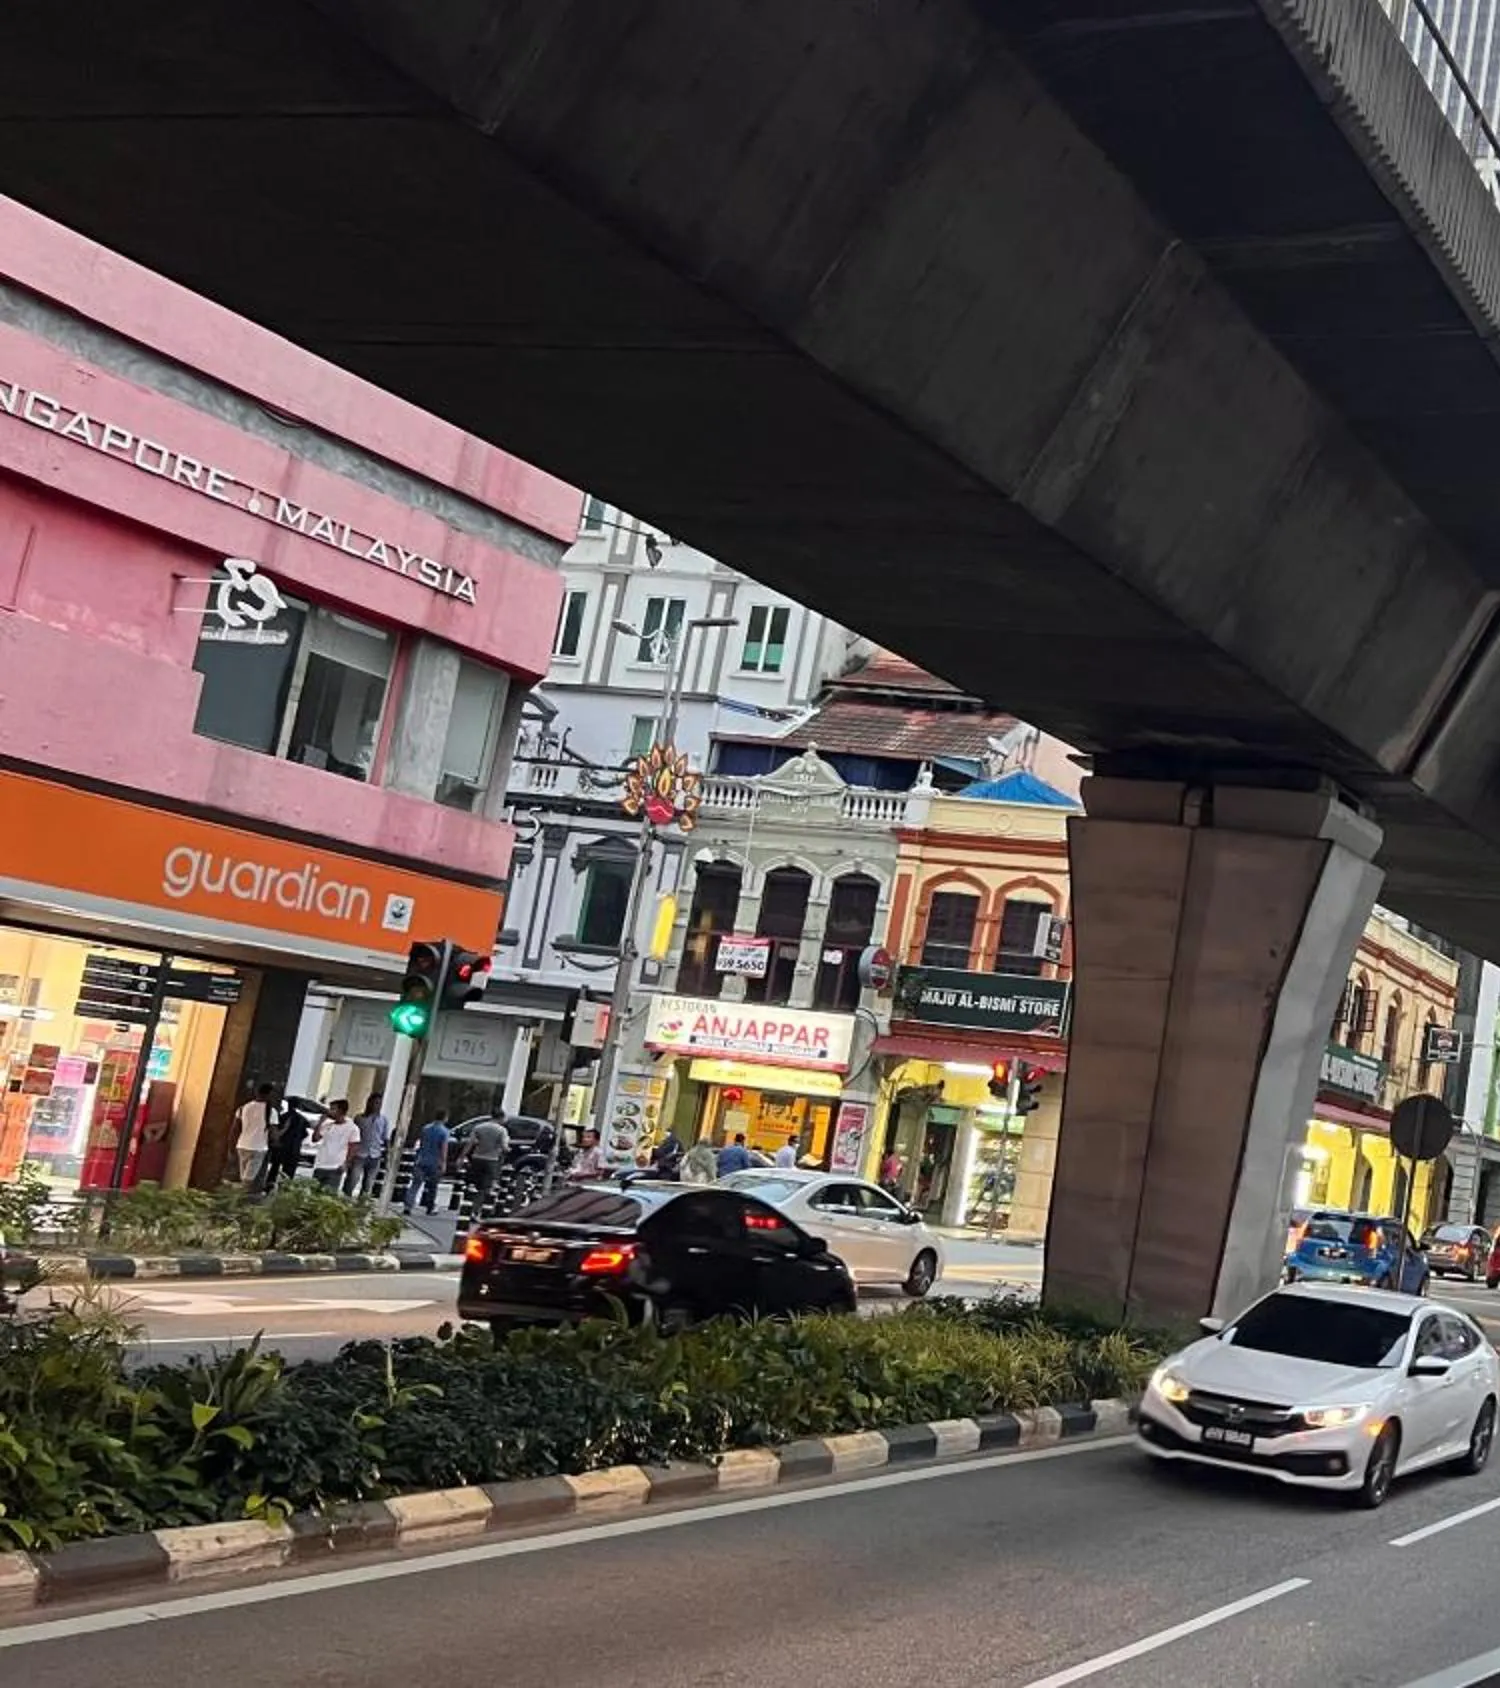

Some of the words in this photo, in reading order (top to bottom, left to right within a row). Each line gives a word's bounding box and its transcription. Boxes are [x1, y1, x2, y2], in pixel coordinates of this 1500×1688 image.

[276, 496, 477, 605] MALAYSIA
[162, 845, 371, 925] guardian
[692, 1014, 831, 1049] ANJAPPAR
[919, 990, 957, 1007] MAJU
[958, 991, 1016, 1014] AL-BISMI
[1019, 999, 1060, 1017] STORE
